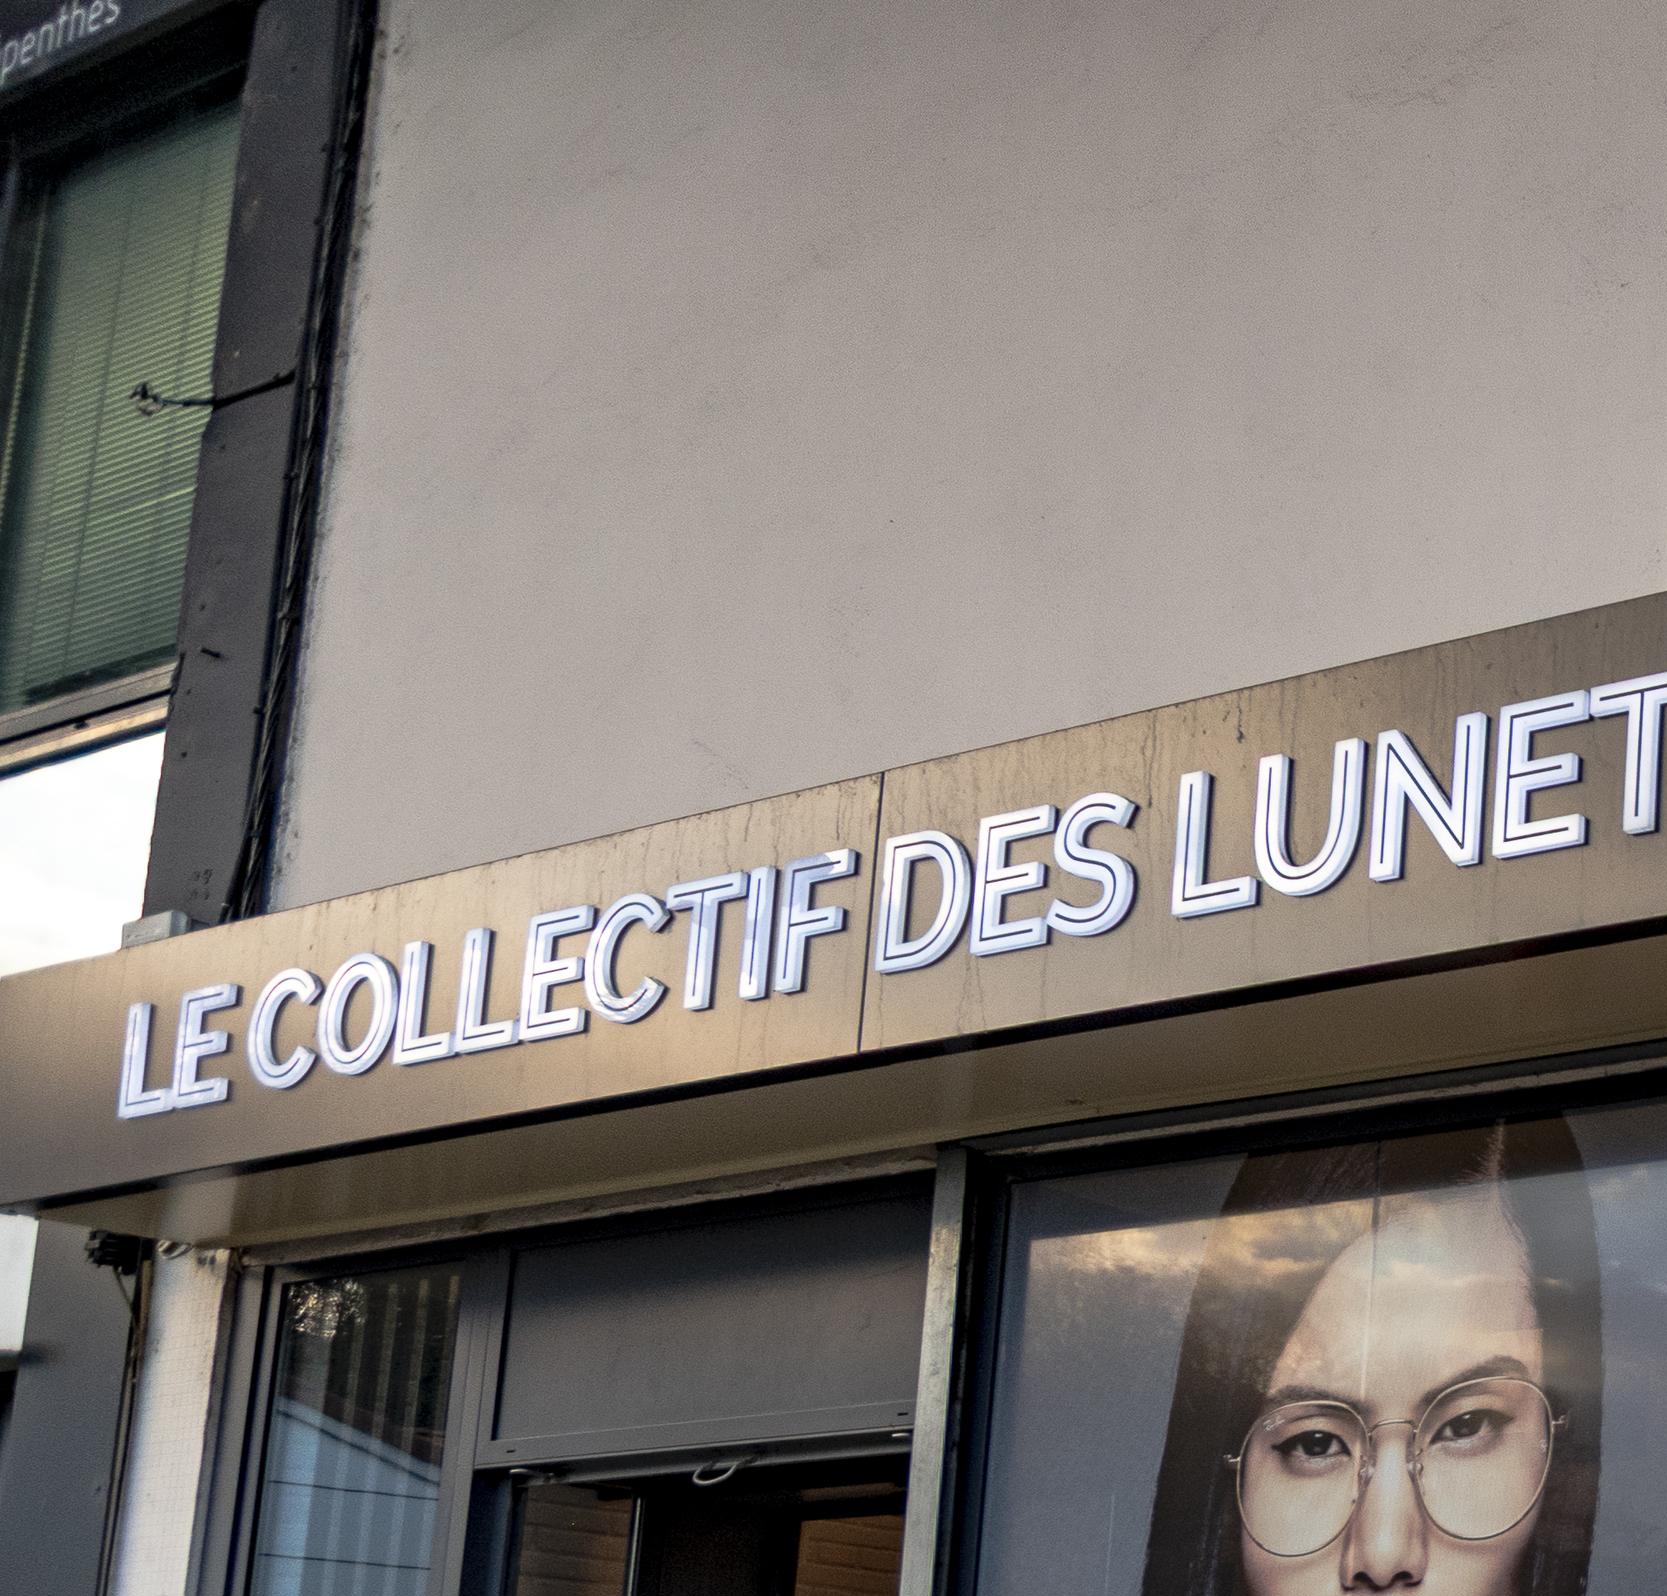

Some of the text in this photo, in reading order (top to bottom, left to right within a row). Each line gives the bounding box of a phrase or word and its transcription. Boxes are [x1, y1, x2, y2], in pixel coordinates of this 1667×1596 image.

[117, 983, 240, 1119] LE
[246, 848, 859, 1089] COLLECTIF
[875, 791, 1137, 973] DES
